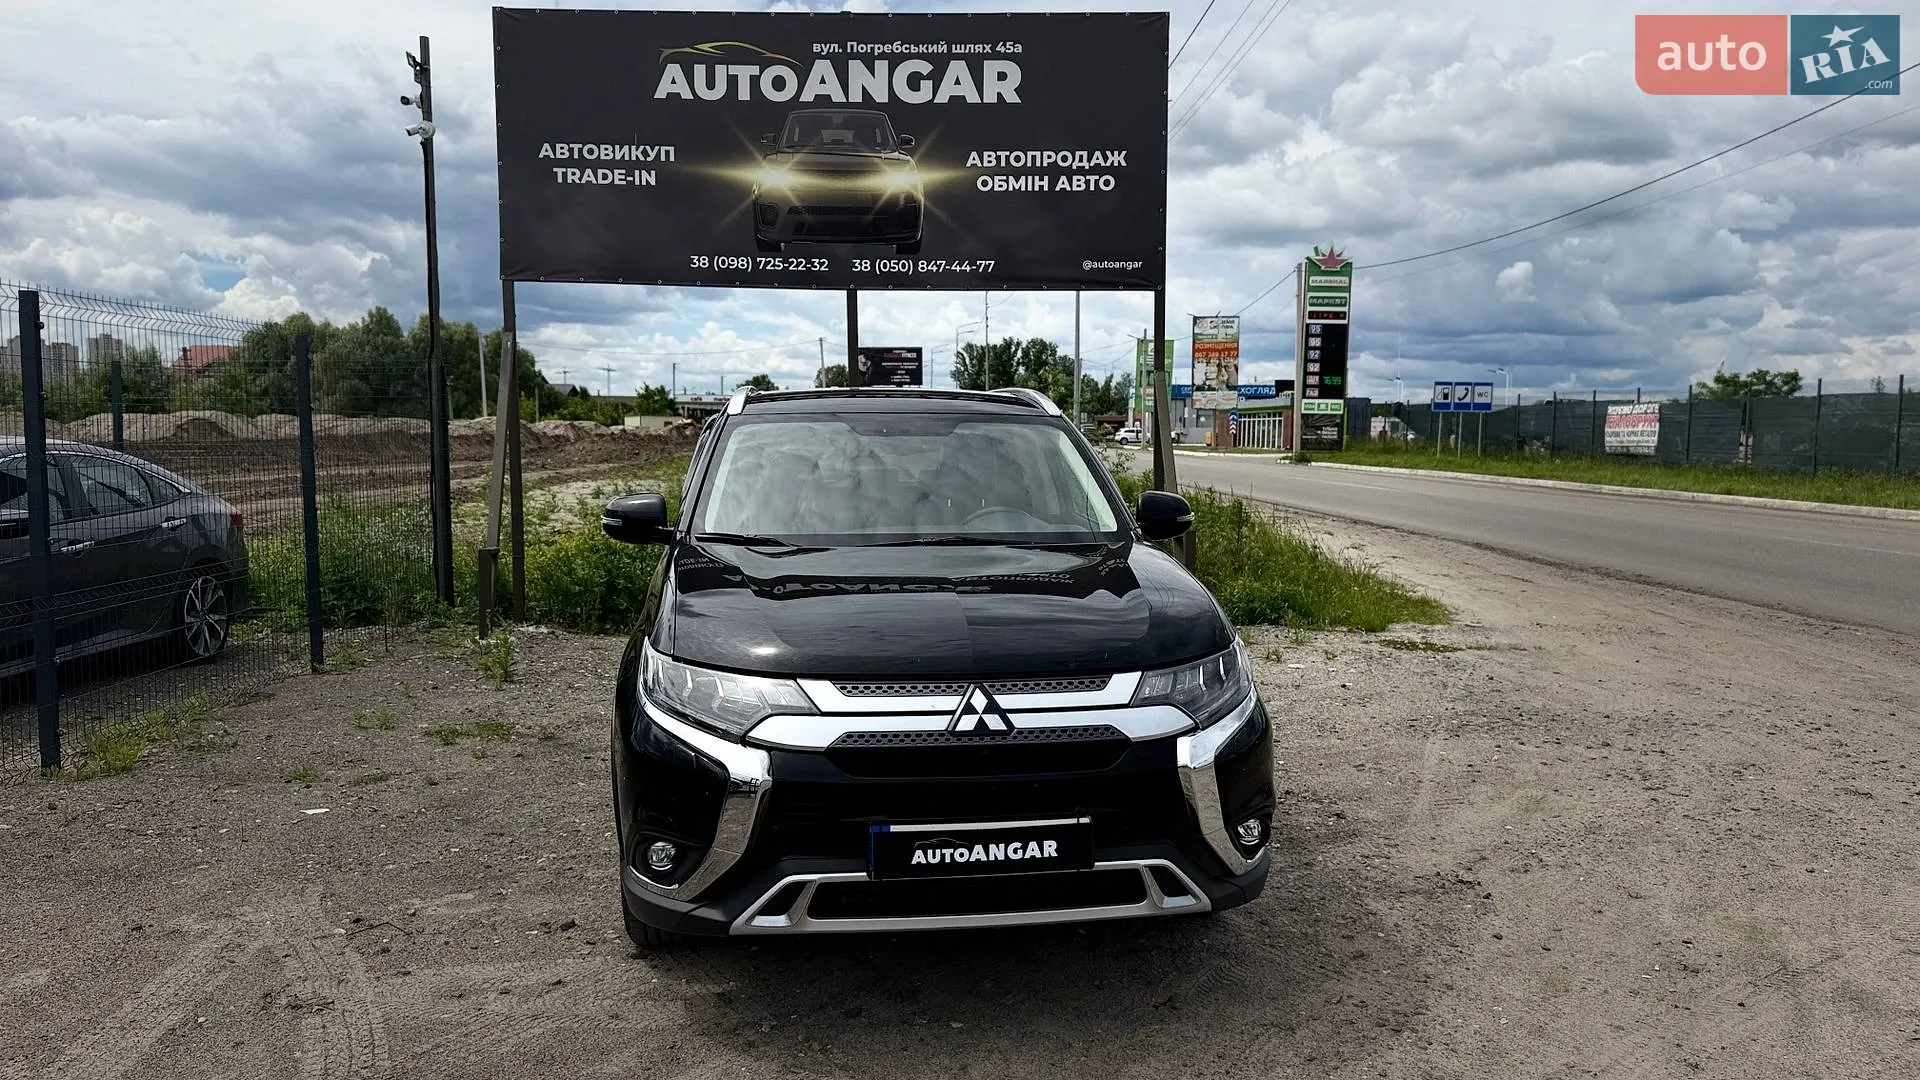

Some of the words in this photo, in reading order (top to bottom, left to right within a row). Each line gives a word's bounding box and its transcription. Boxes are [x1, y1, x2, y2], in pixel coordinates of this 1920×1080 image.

[812, 43, 842, 56] вул.
[847, 40, 947, 56] Погребський
[951, 43, 991, 54] шлях
[995, 42, 1022, 54] 45а
[653, 59, 1022, 104] AUTOANGAR
[538, 142, 675, 162] АВТОВИКУП
[966, 150, 1127, 170] АВТОПРОДАЖ
[553, 167, 656, 186] TRADE-IN
[976, 175, 1049, 192] ОБМІН
[1054, 174, 1116, 192] АВТО
[690, 256, 710, 269] 38
[713, 255, 752, 272] (098)
[756, 257, 829, 272] 725-22-32
[851, 259, 871, 272] 38
[875, 258, 914, 275] (050)
[917, 259, 995, 273] 847-44-77
[1082, 259, 1143, 271] @autoangar
[1238, 386, 1275, 395] ХОГЛЯД
[911, 840, 1058, 865] AUTOANGAR
